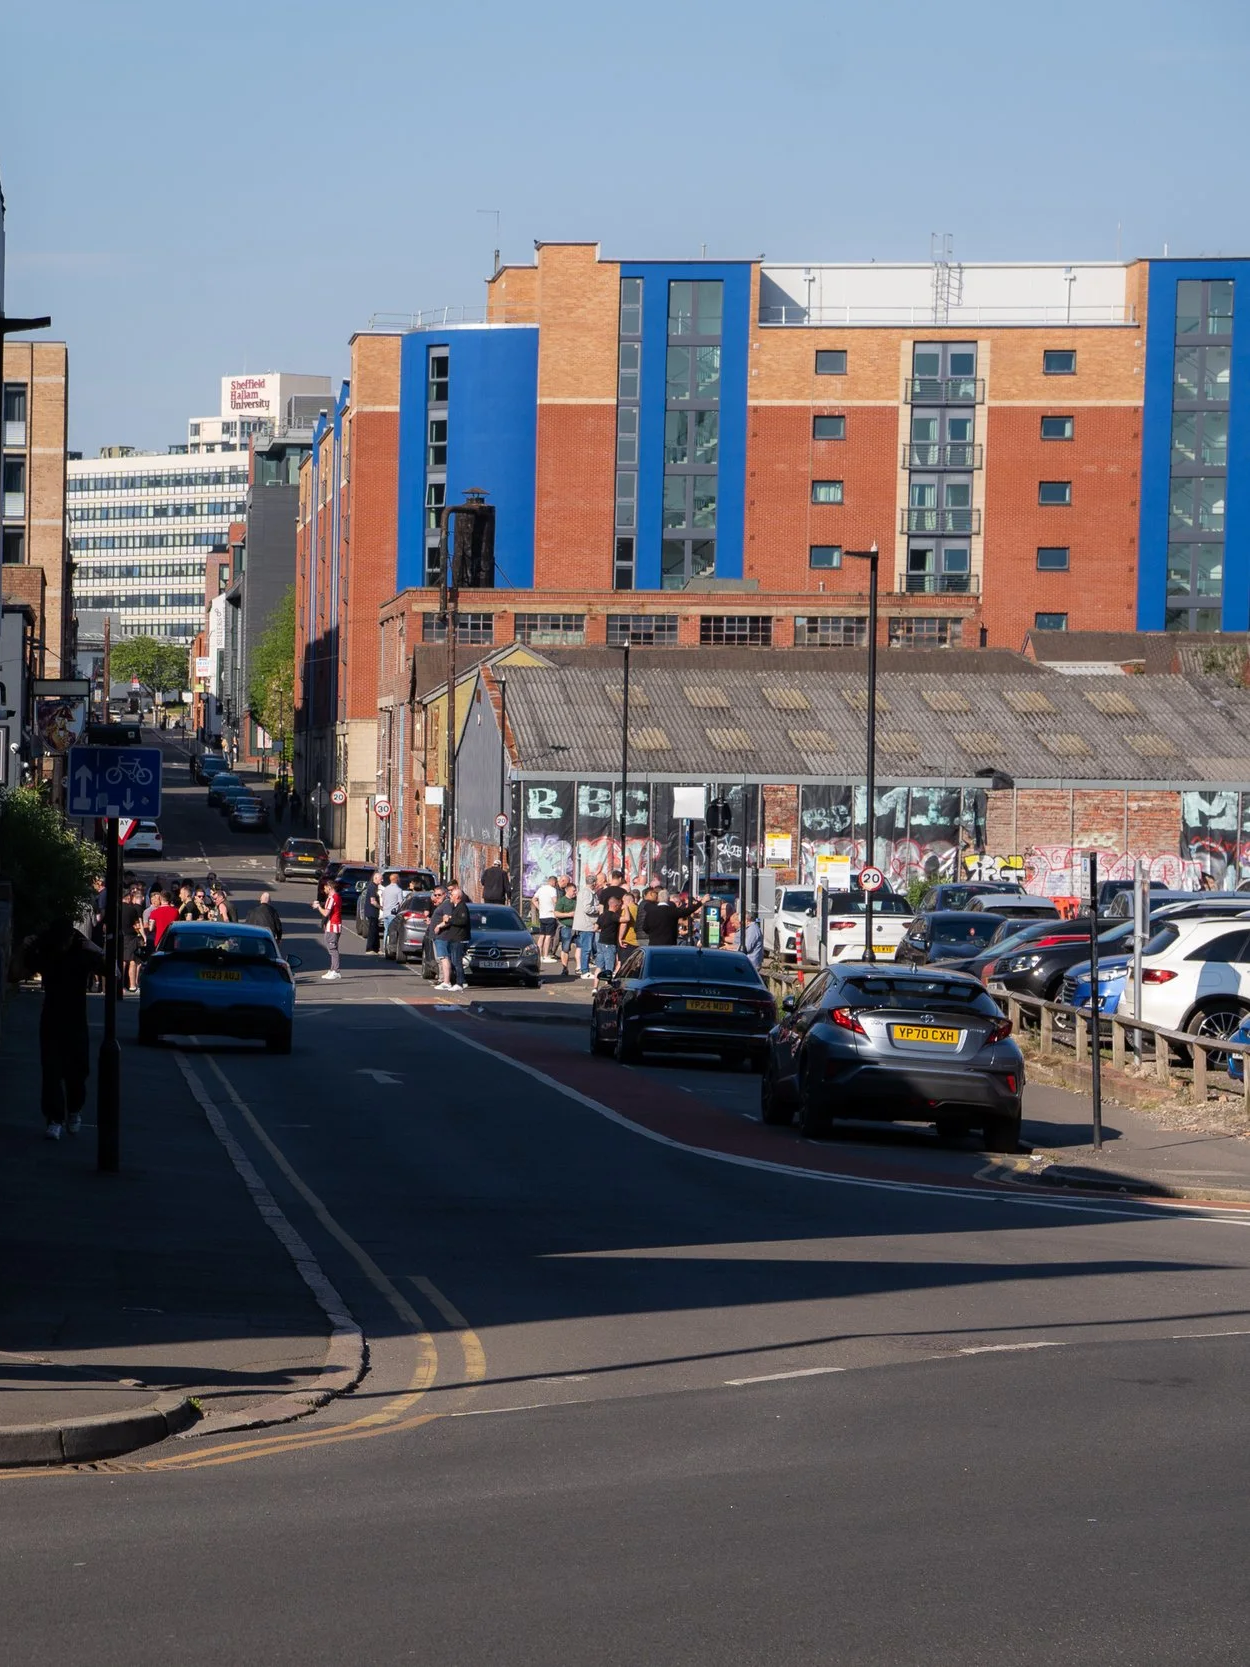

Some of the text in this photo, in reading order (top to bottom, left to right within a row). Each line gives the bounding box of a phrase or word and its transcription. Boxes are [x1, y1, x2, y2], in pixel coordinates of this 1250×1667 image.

[231, 379, 266, 390] Sheffield
[231, 390, 259, 400] Hallam
[231, 399, 270, 410] University
[333, 793, 343, 801] 20
[378, 804, 389, 814] 30
[497, 816, 507, 825] 20
[863, 873, 880, 884] 20
[899, 1027, 928, 1040] YP70
[932, 1029, 954, 1042] CXH
